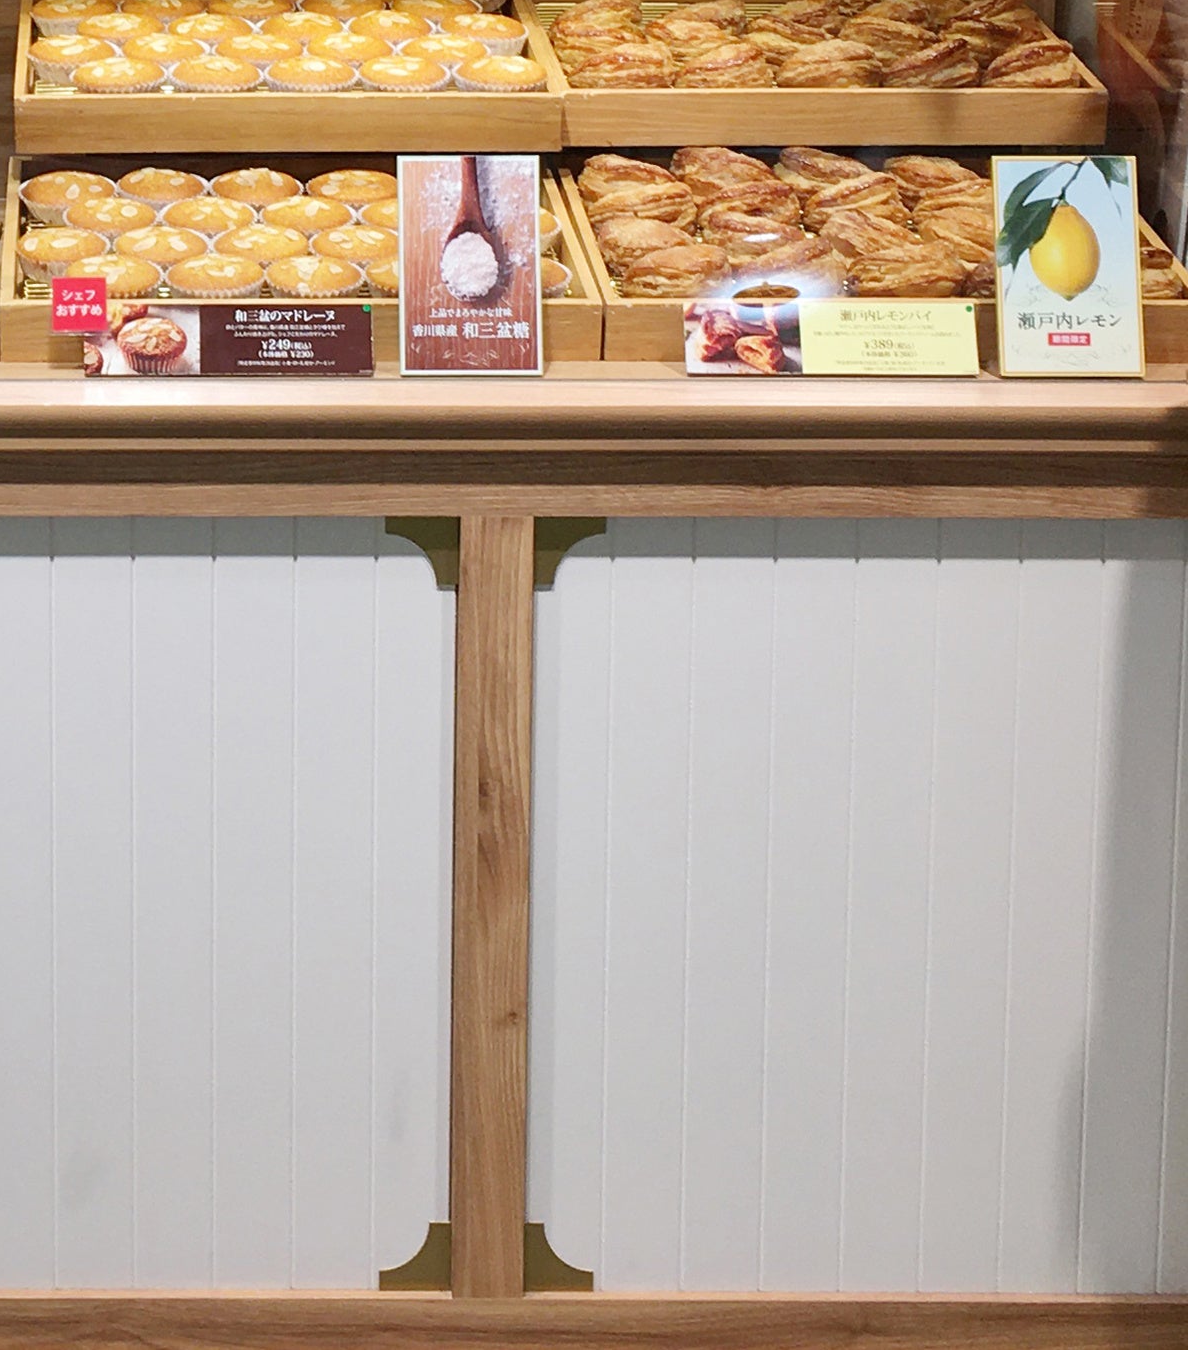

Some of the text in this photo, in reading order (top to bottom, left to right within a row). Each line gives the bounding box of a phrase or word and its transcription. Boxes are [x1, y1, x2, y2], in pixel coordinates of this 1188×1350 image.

[61, 289, 96, 301] シェフ
[55, 303, 103, 317] おすすめ
[235, 309, 336, 322] 和三盆のマドレーヌ
[1016, 311, 1123, 330] 瀬戸内レモン
[412, 321, 530, 339] 香川県産 和三盆糖
